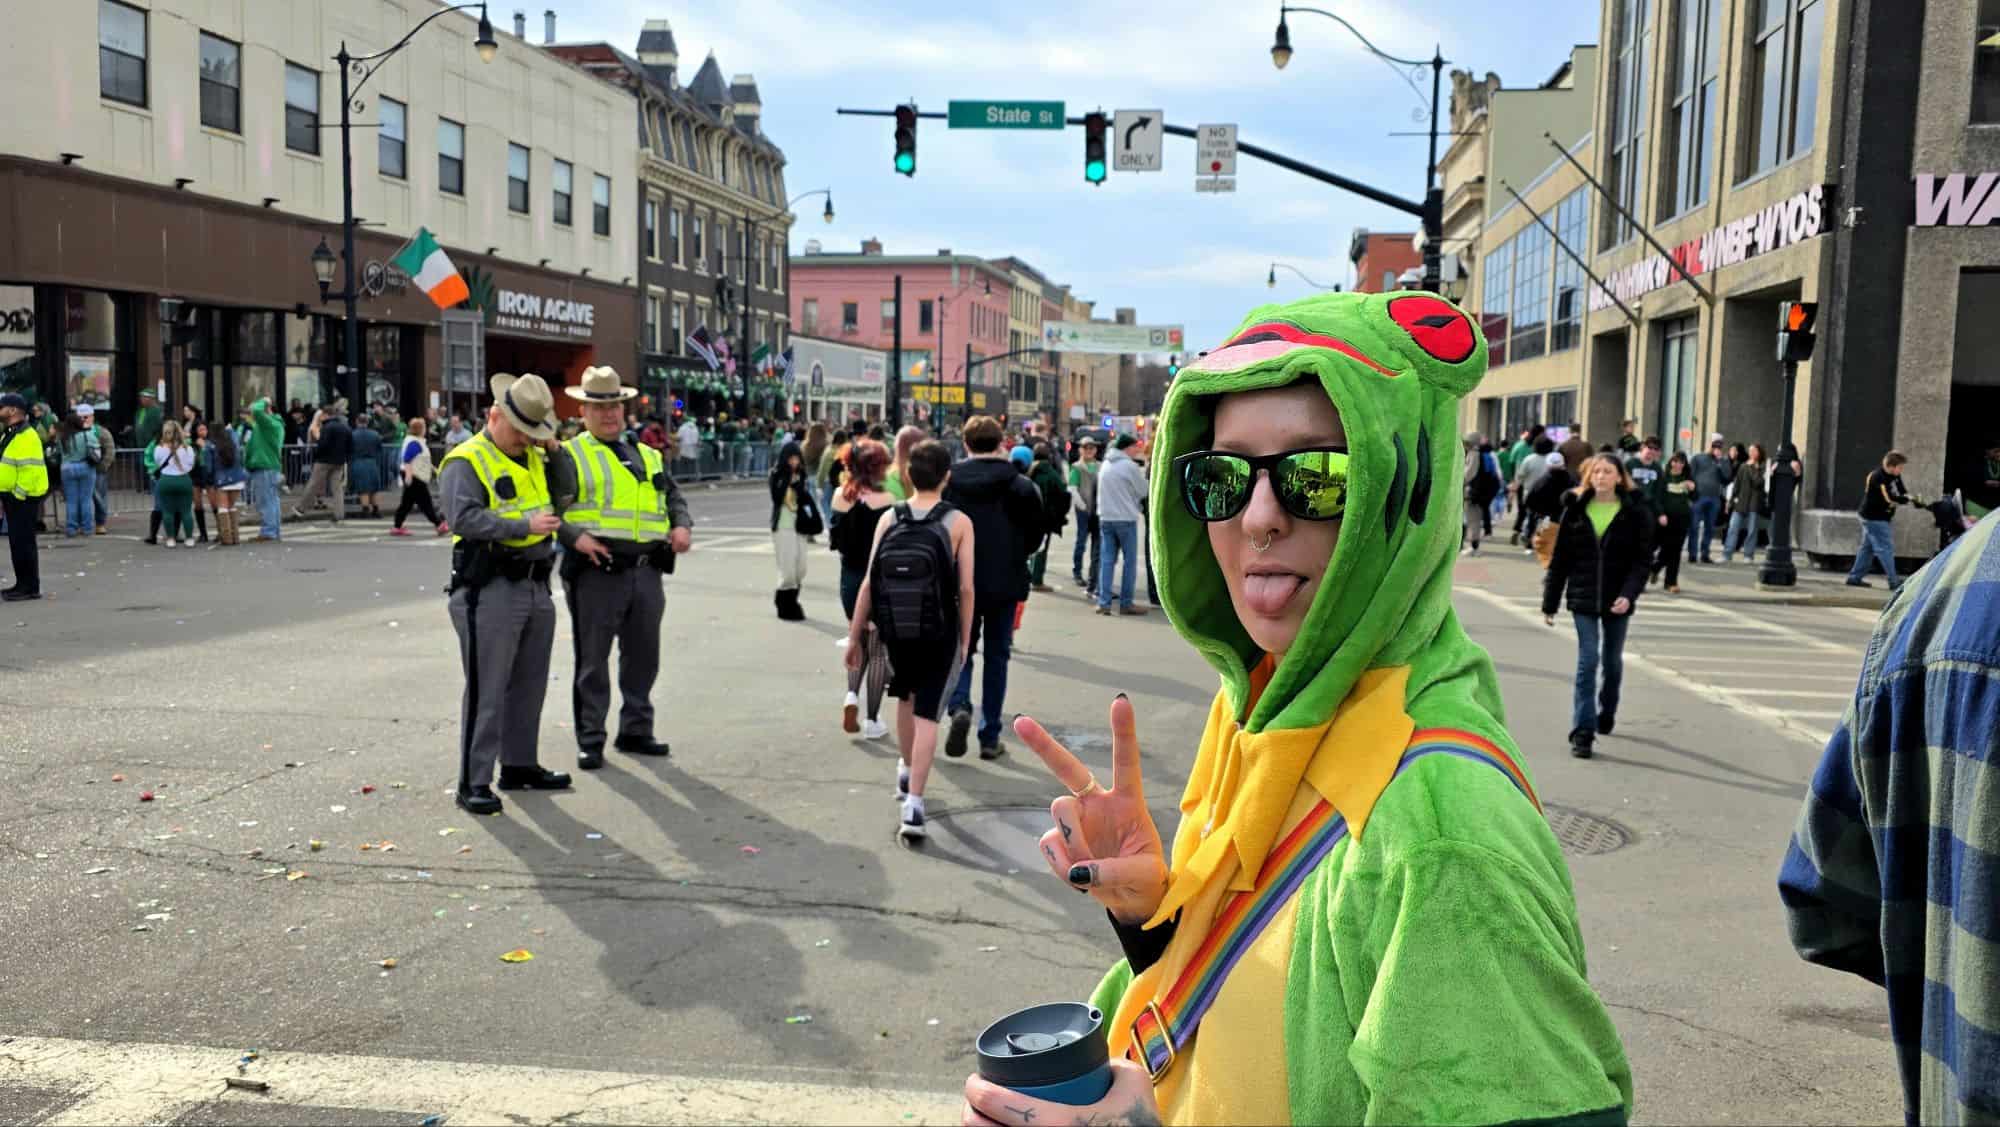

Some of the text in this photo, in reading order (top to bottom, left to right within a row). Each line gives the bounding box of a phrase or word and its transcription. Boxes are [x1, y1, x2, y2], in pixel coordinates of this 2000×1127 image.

[986, 106, 1053, 124] State St
[1208, 128, 1226, 137] NO
[1119, 154, 1154, 166] ONLY
[497, 289, 595, 327] IRON AGAVE
